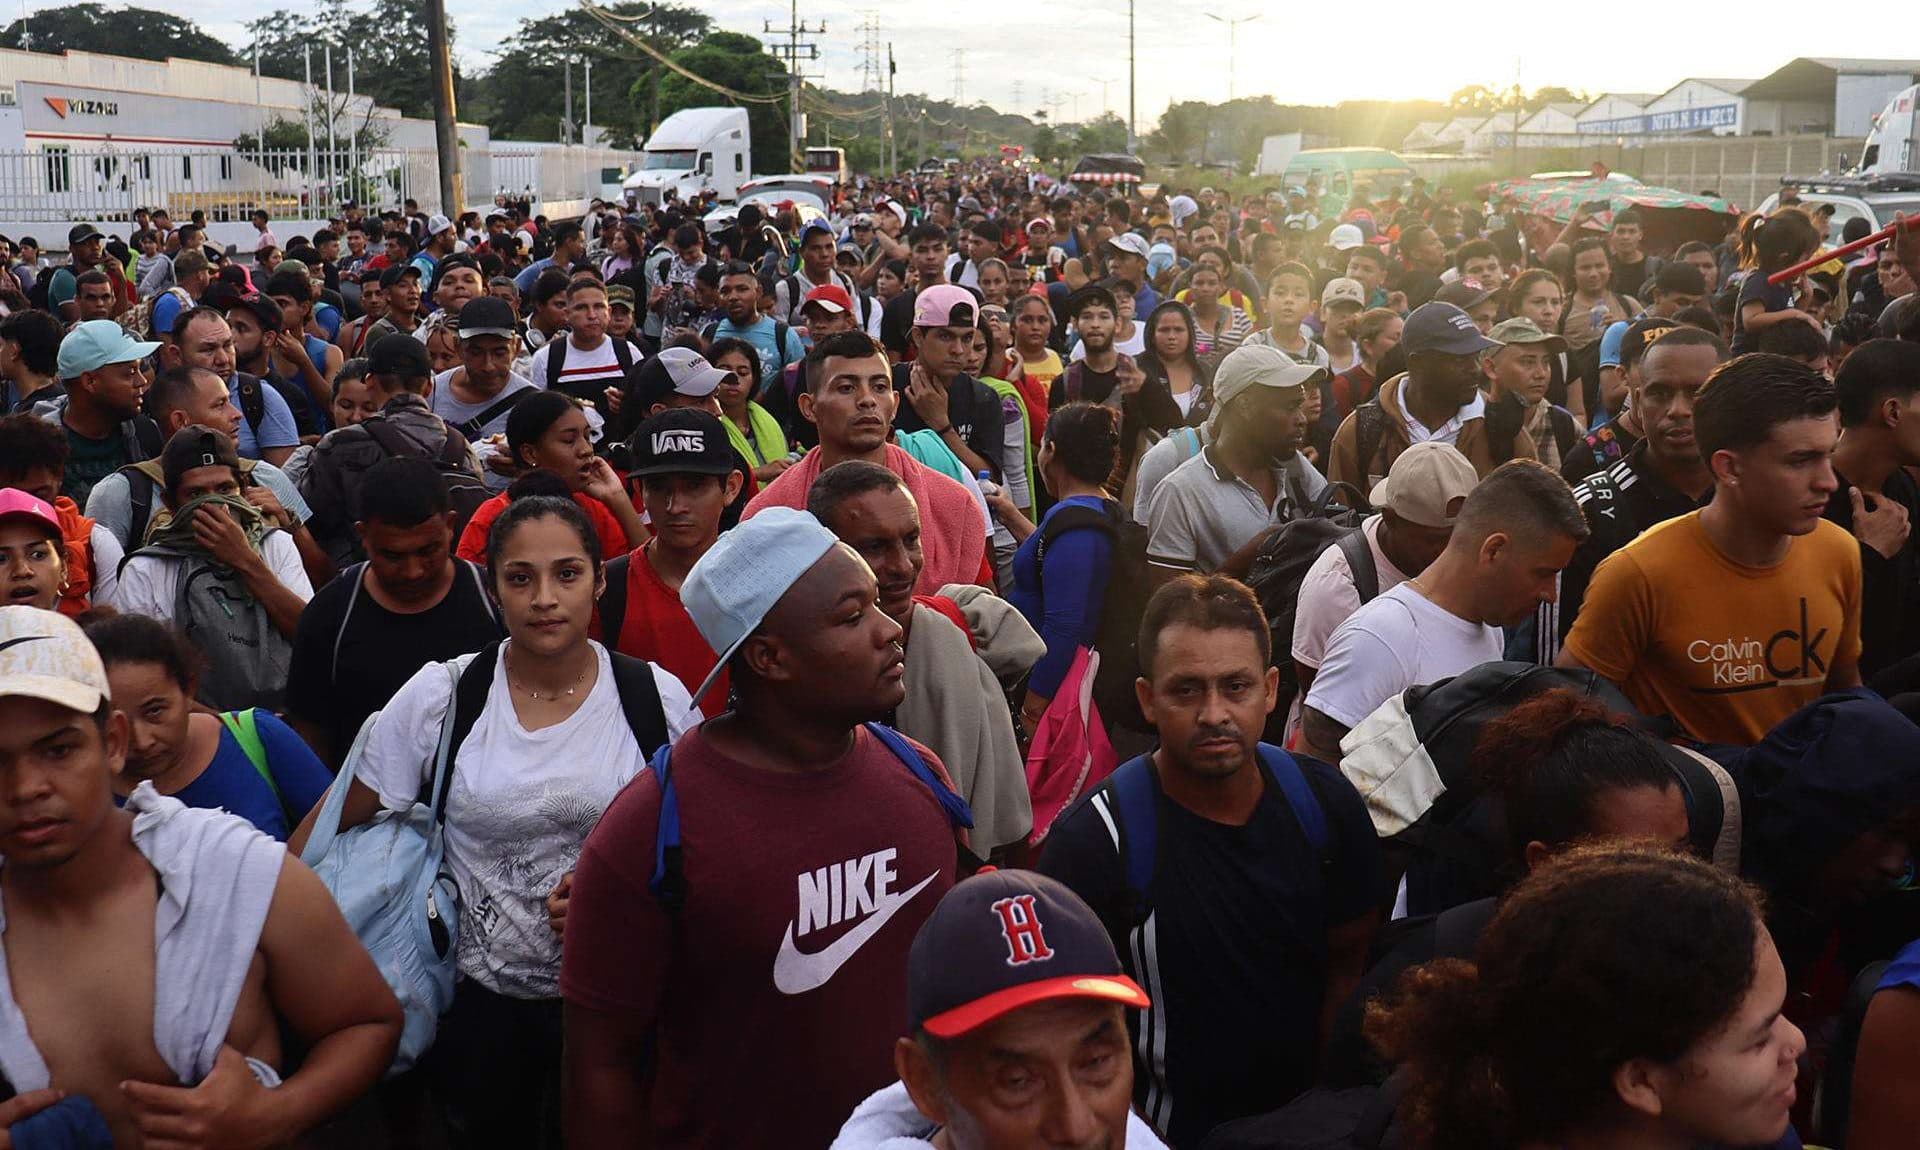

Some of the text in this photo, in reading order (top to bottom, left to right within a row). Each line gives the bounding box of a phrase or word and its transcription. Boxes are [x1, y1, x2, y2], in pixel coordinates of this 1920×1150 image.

[67, 99, 118, 116] YAZAKI
[651, 429, 705, 455] VANS
[1687, 637, 1763, 664] Calvin
[1713, 660, 1764, 685] Klein
[798, 848, 899, 937] NIKE
[991, 894, 1055, 966] H
